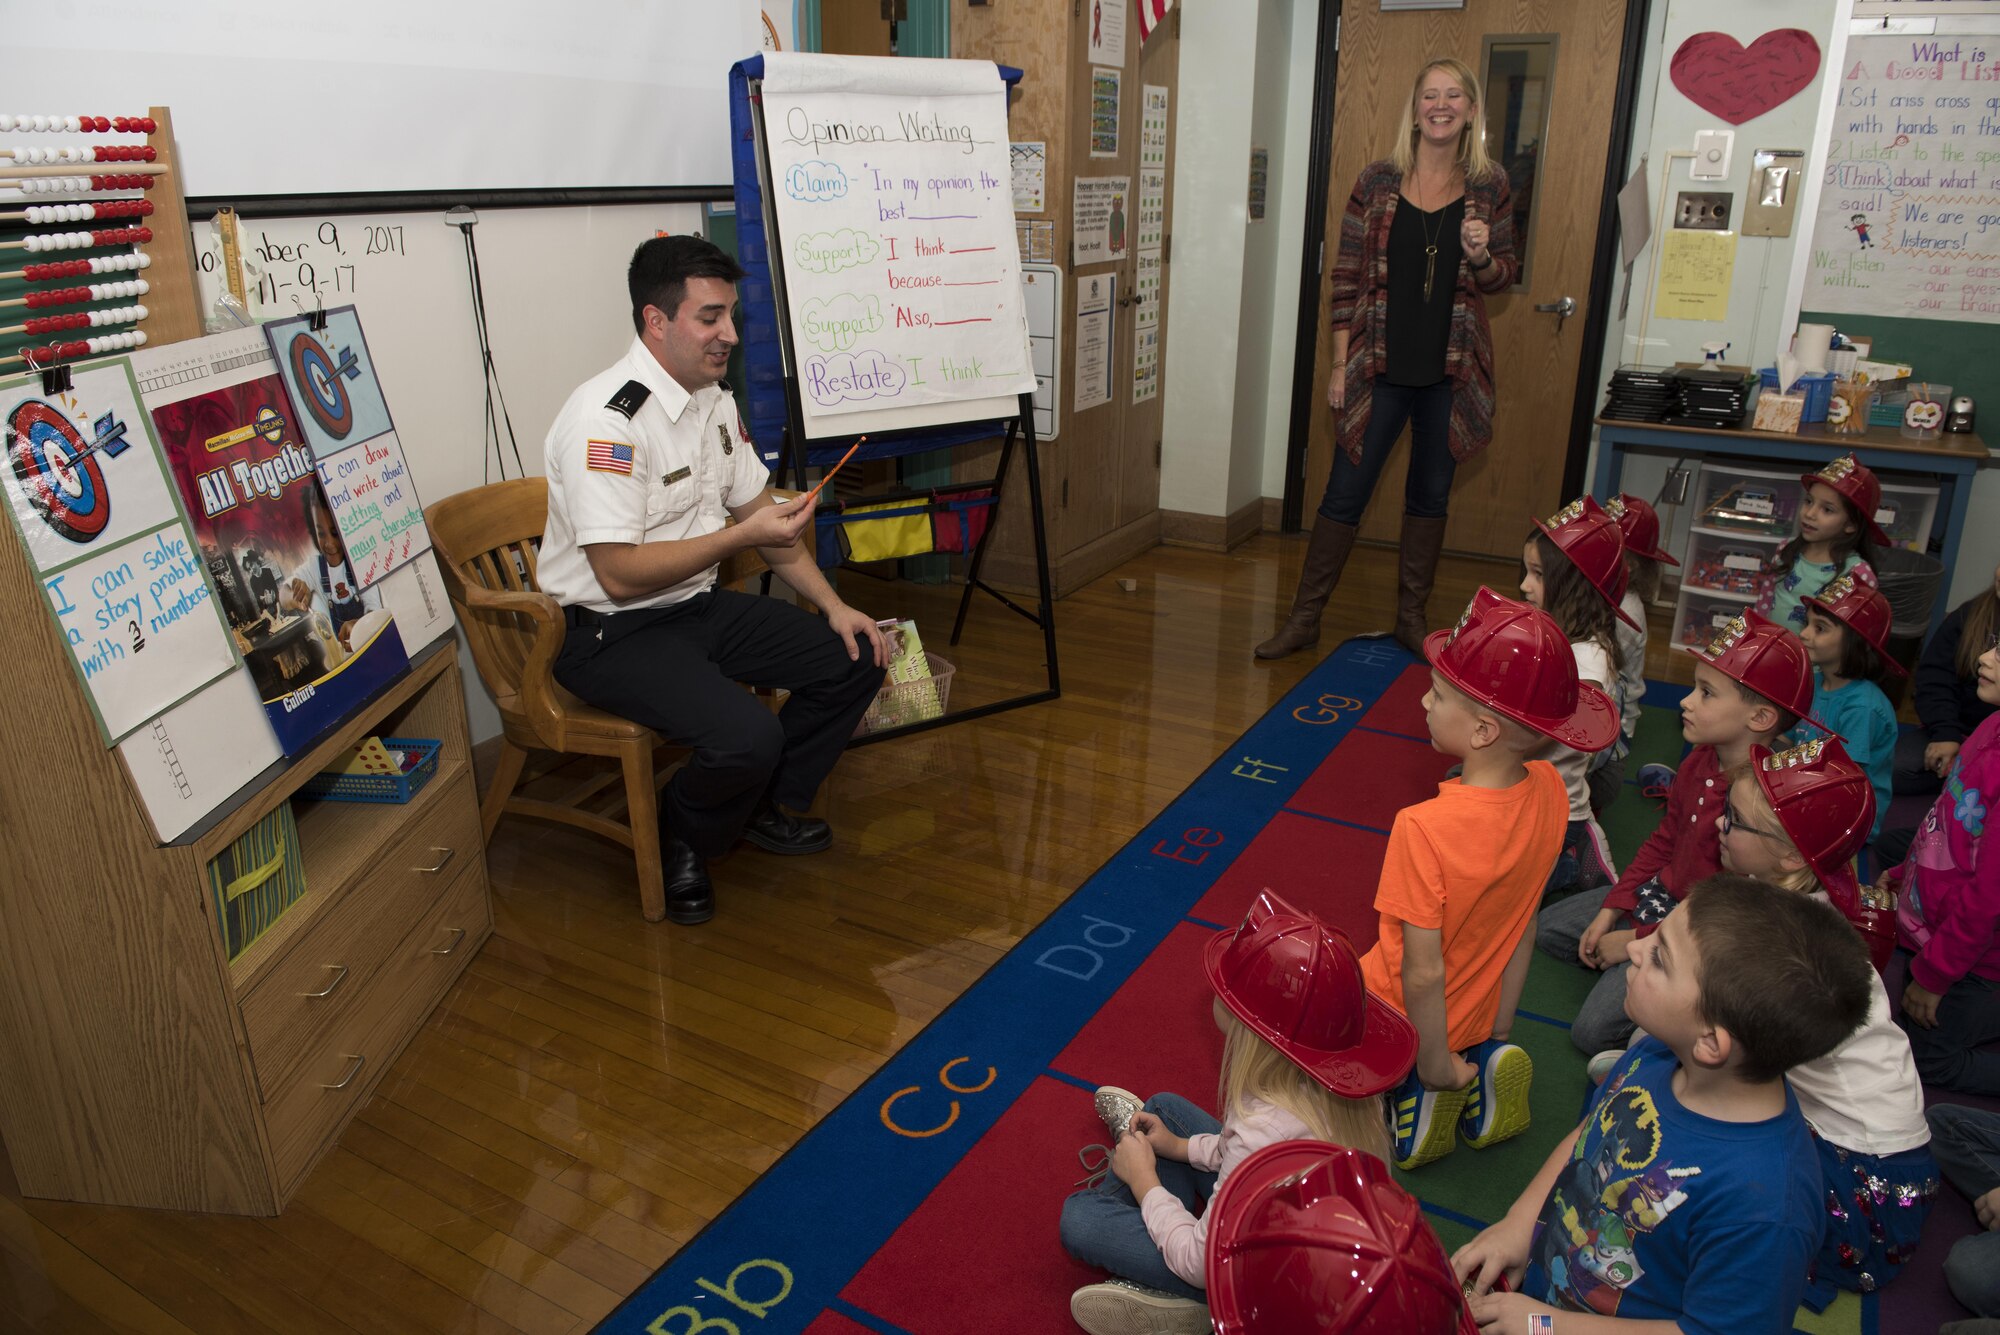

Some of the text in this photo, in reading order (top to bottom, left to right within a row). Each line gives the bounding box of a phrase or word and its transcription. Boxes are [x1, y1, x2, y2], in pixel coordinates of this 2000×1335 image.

[1912, 42, 1986, 62] What is
[1846, 60, 1871, 80] A
[1886, 60, 1944, 81] Good
[1850, 86, 1878, 108] Sit
[1890, 95, 1925, 108] criss
[1935, 95, 1971, 108] cross
[786, 106, 975, 155] Opinion Writing
[1850, 114, 1883, 136] with
[1896, 114, 1938, 136] hands
[1952, 121, 1966, 136] in
[1850, 142, 1899, 161] Listen
[1914, 143, 1929, 161] to
[1942, 143, 1965, 162] the
[793, 168, 842, 194] Claim
[903, 179, 920, 200] my
[927, 177, 976, 200] opinion,
[978, 170, 1000, 190] the
[1841, 165, 1887, 186] Think
[1893, 168, 1934, 188] about
[1940, 169, 1978, 190] what
[878, 200, 906, 222] best
[1839, 193, 1883, 212] said!
[1905, 202, 1929, 223] We
[1936, 211, 1964, 225] are
[364, 226, 405, 256] 2017
[914, 236, 946, 258] think
[1900, 229, 1969, 251] listeners!
[1814, 250, 1886, 273] We listen
[1929, 264, 1957, 276] our
[258, 262, 355, 305] 11-9-17
[888, 268, 943, 290] because
[1924, 282, 1950, 293] our
[1918, 298, 1946, 310] our
[806, 309, 876, 346] Support
[811, 358, 896, 397] Restate
[938, 354, 984, 381] think
[318, 444, 390, 486] I can draw
[198, 469, 237, 516] All
[330, 460, 405, 510] and write about
[340, 484, 403, 532] setting and
[350, 534, 377, 560] main
[46, 533, 188, 616] I can solve
[67, 628, 85, 646] a
[95, 592, 144, 631] story
[82, 637, 126, 680] with
[128, 620, 142, 643] 3
[1348, 644, 1400, 668] Hh
[282, 683, 316, 714] Culture
[1292, 693, 1364, 725] Gg
[1230, 756, 1289, 784] Ff
[1151, 826, 1225, 866] Ee
[1034, 914, 1137, 982] Dd
[880, 1056, 998, 1138] Cc
[644, 1258, 794, 1335] Bb
